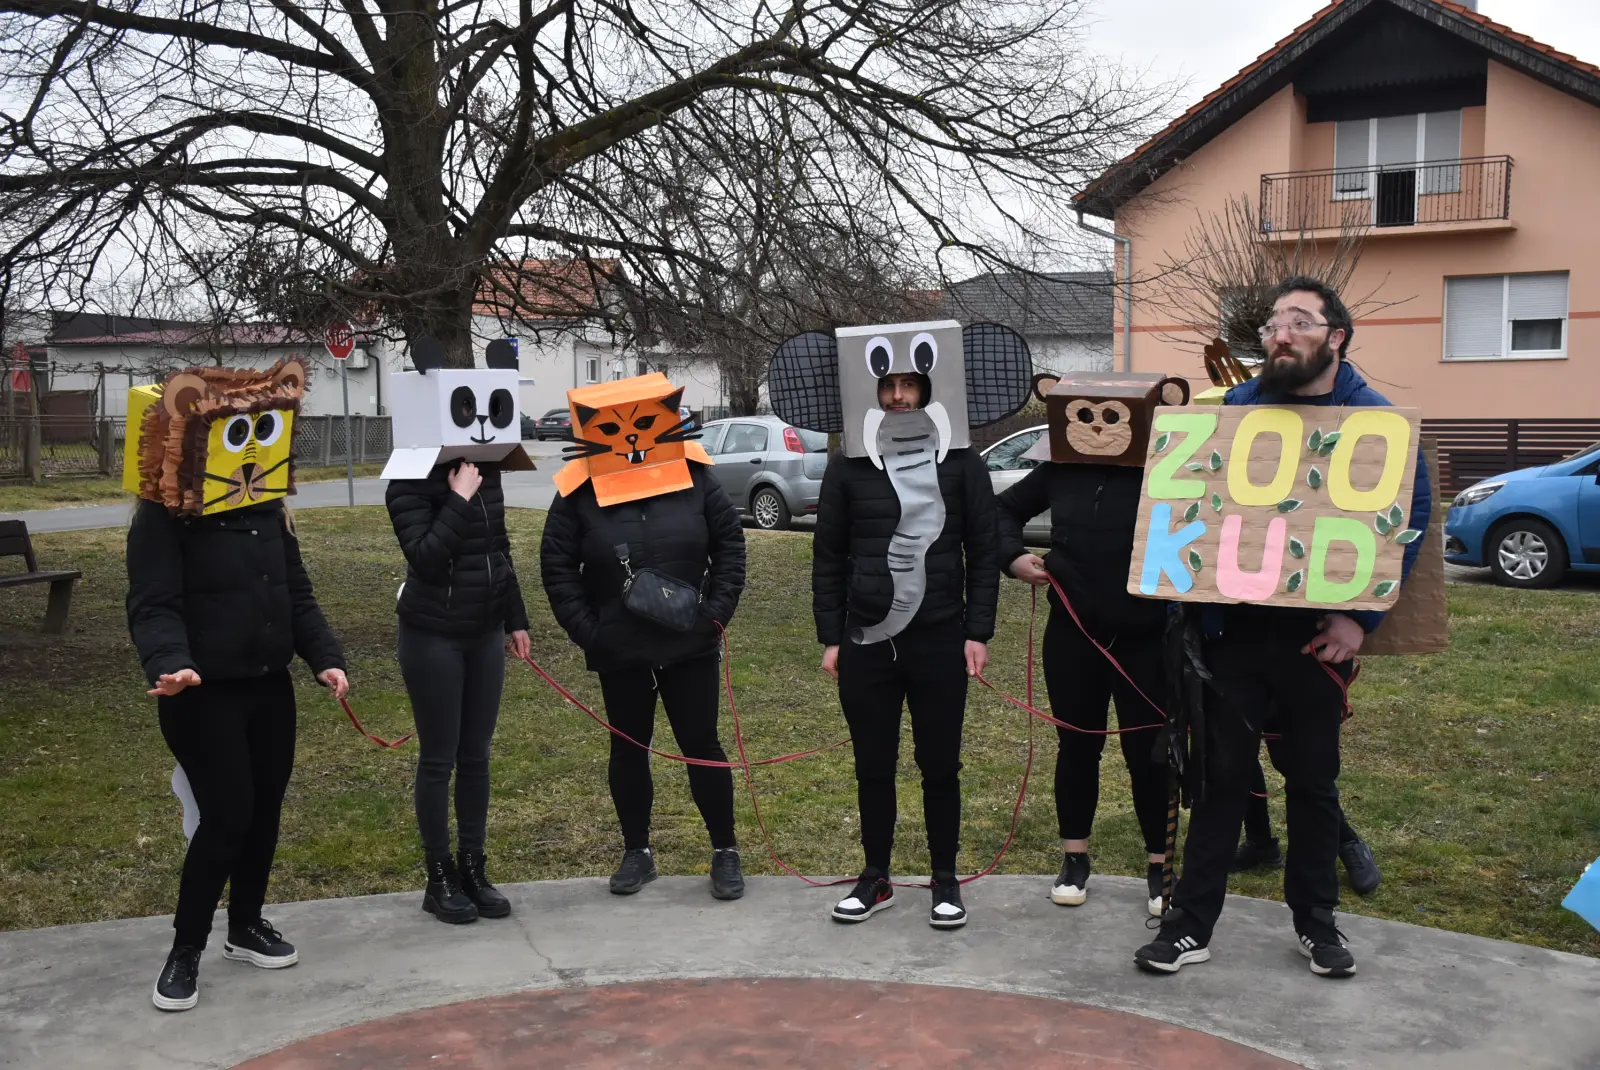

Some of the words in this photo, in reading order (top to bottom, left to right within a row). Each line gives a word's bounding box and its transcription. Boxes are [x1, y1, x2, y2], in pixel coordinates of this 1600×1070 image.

[326, 329, 351, 347] STOP
[1148, 409, 1410, 511] ZOO
[1140, 503, 1376, 603] KUD
